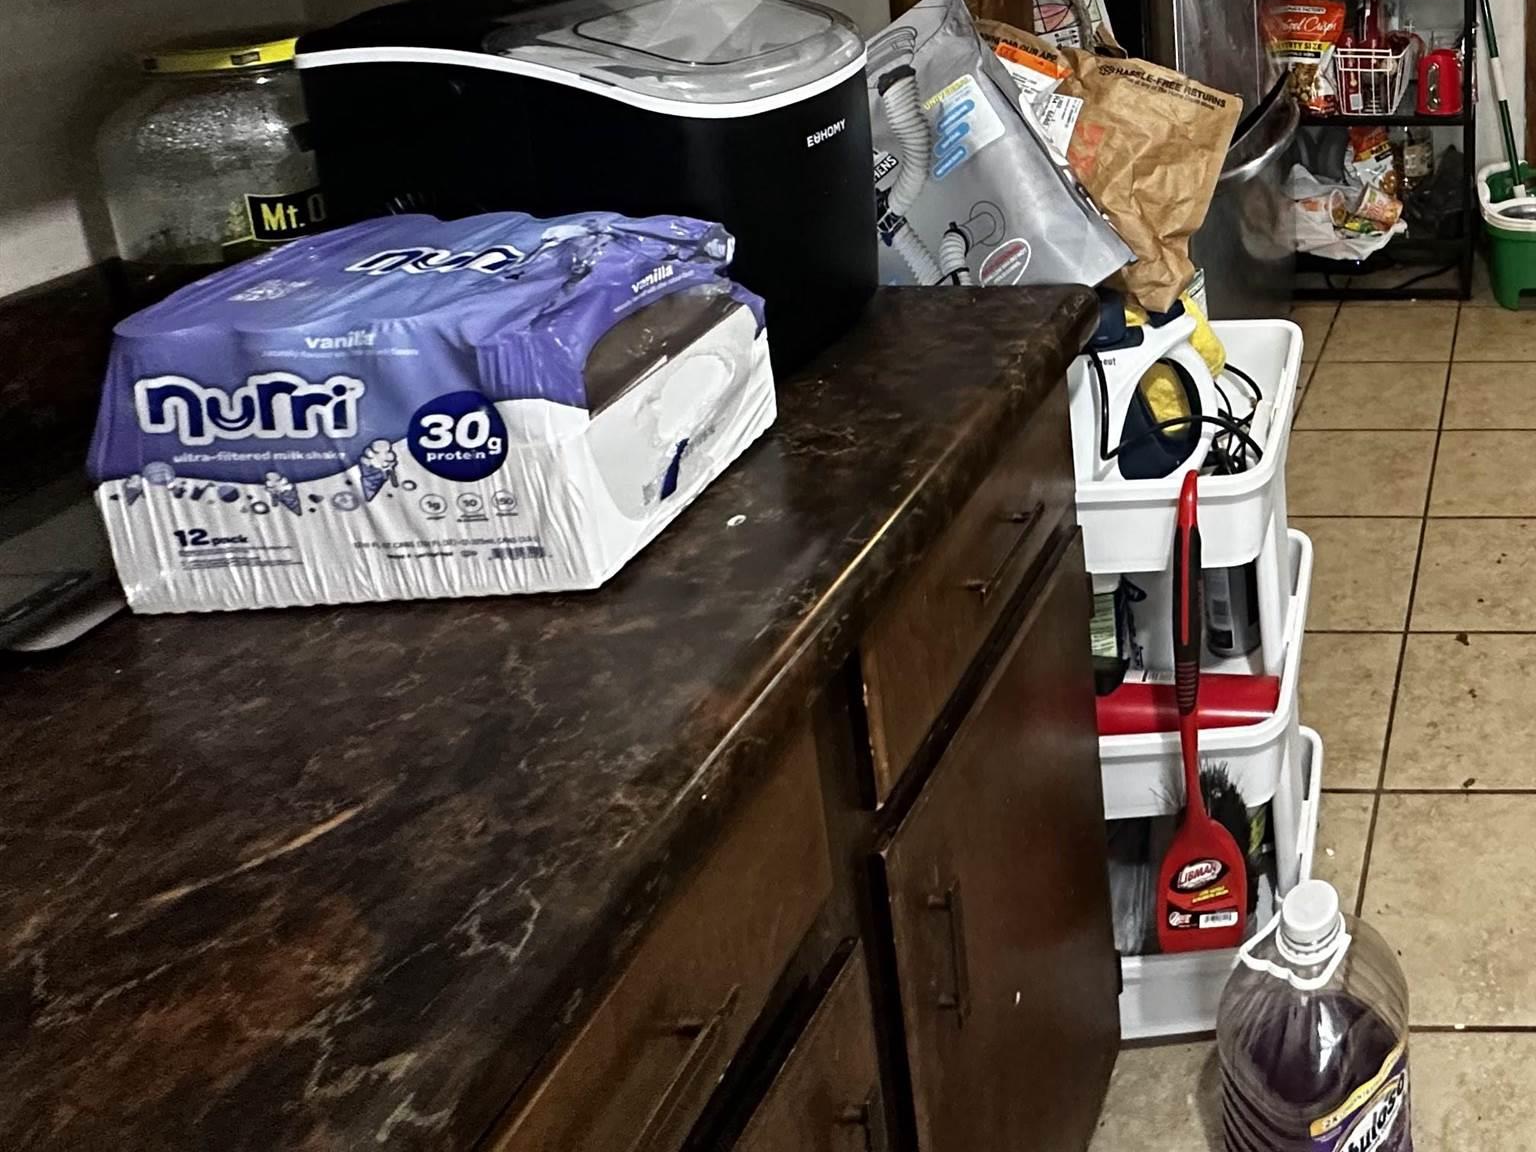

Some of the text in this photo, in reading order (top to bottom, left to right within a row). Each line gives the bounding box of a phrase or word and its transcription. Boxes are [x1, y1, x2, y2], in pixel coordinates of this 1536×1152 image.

[1115, 67, 1227, 108] HASSLE-FREE RETURNS
[260, 202, 306, 232] Mt.
[632, 264, 674, 294] vanilla
[139, 375, 360, 443] nurri
[173, 451, 271, 463] ultra-filtered
[426, 450, 487, 463] protein
[173, 528, 249, 548] 12 pack
